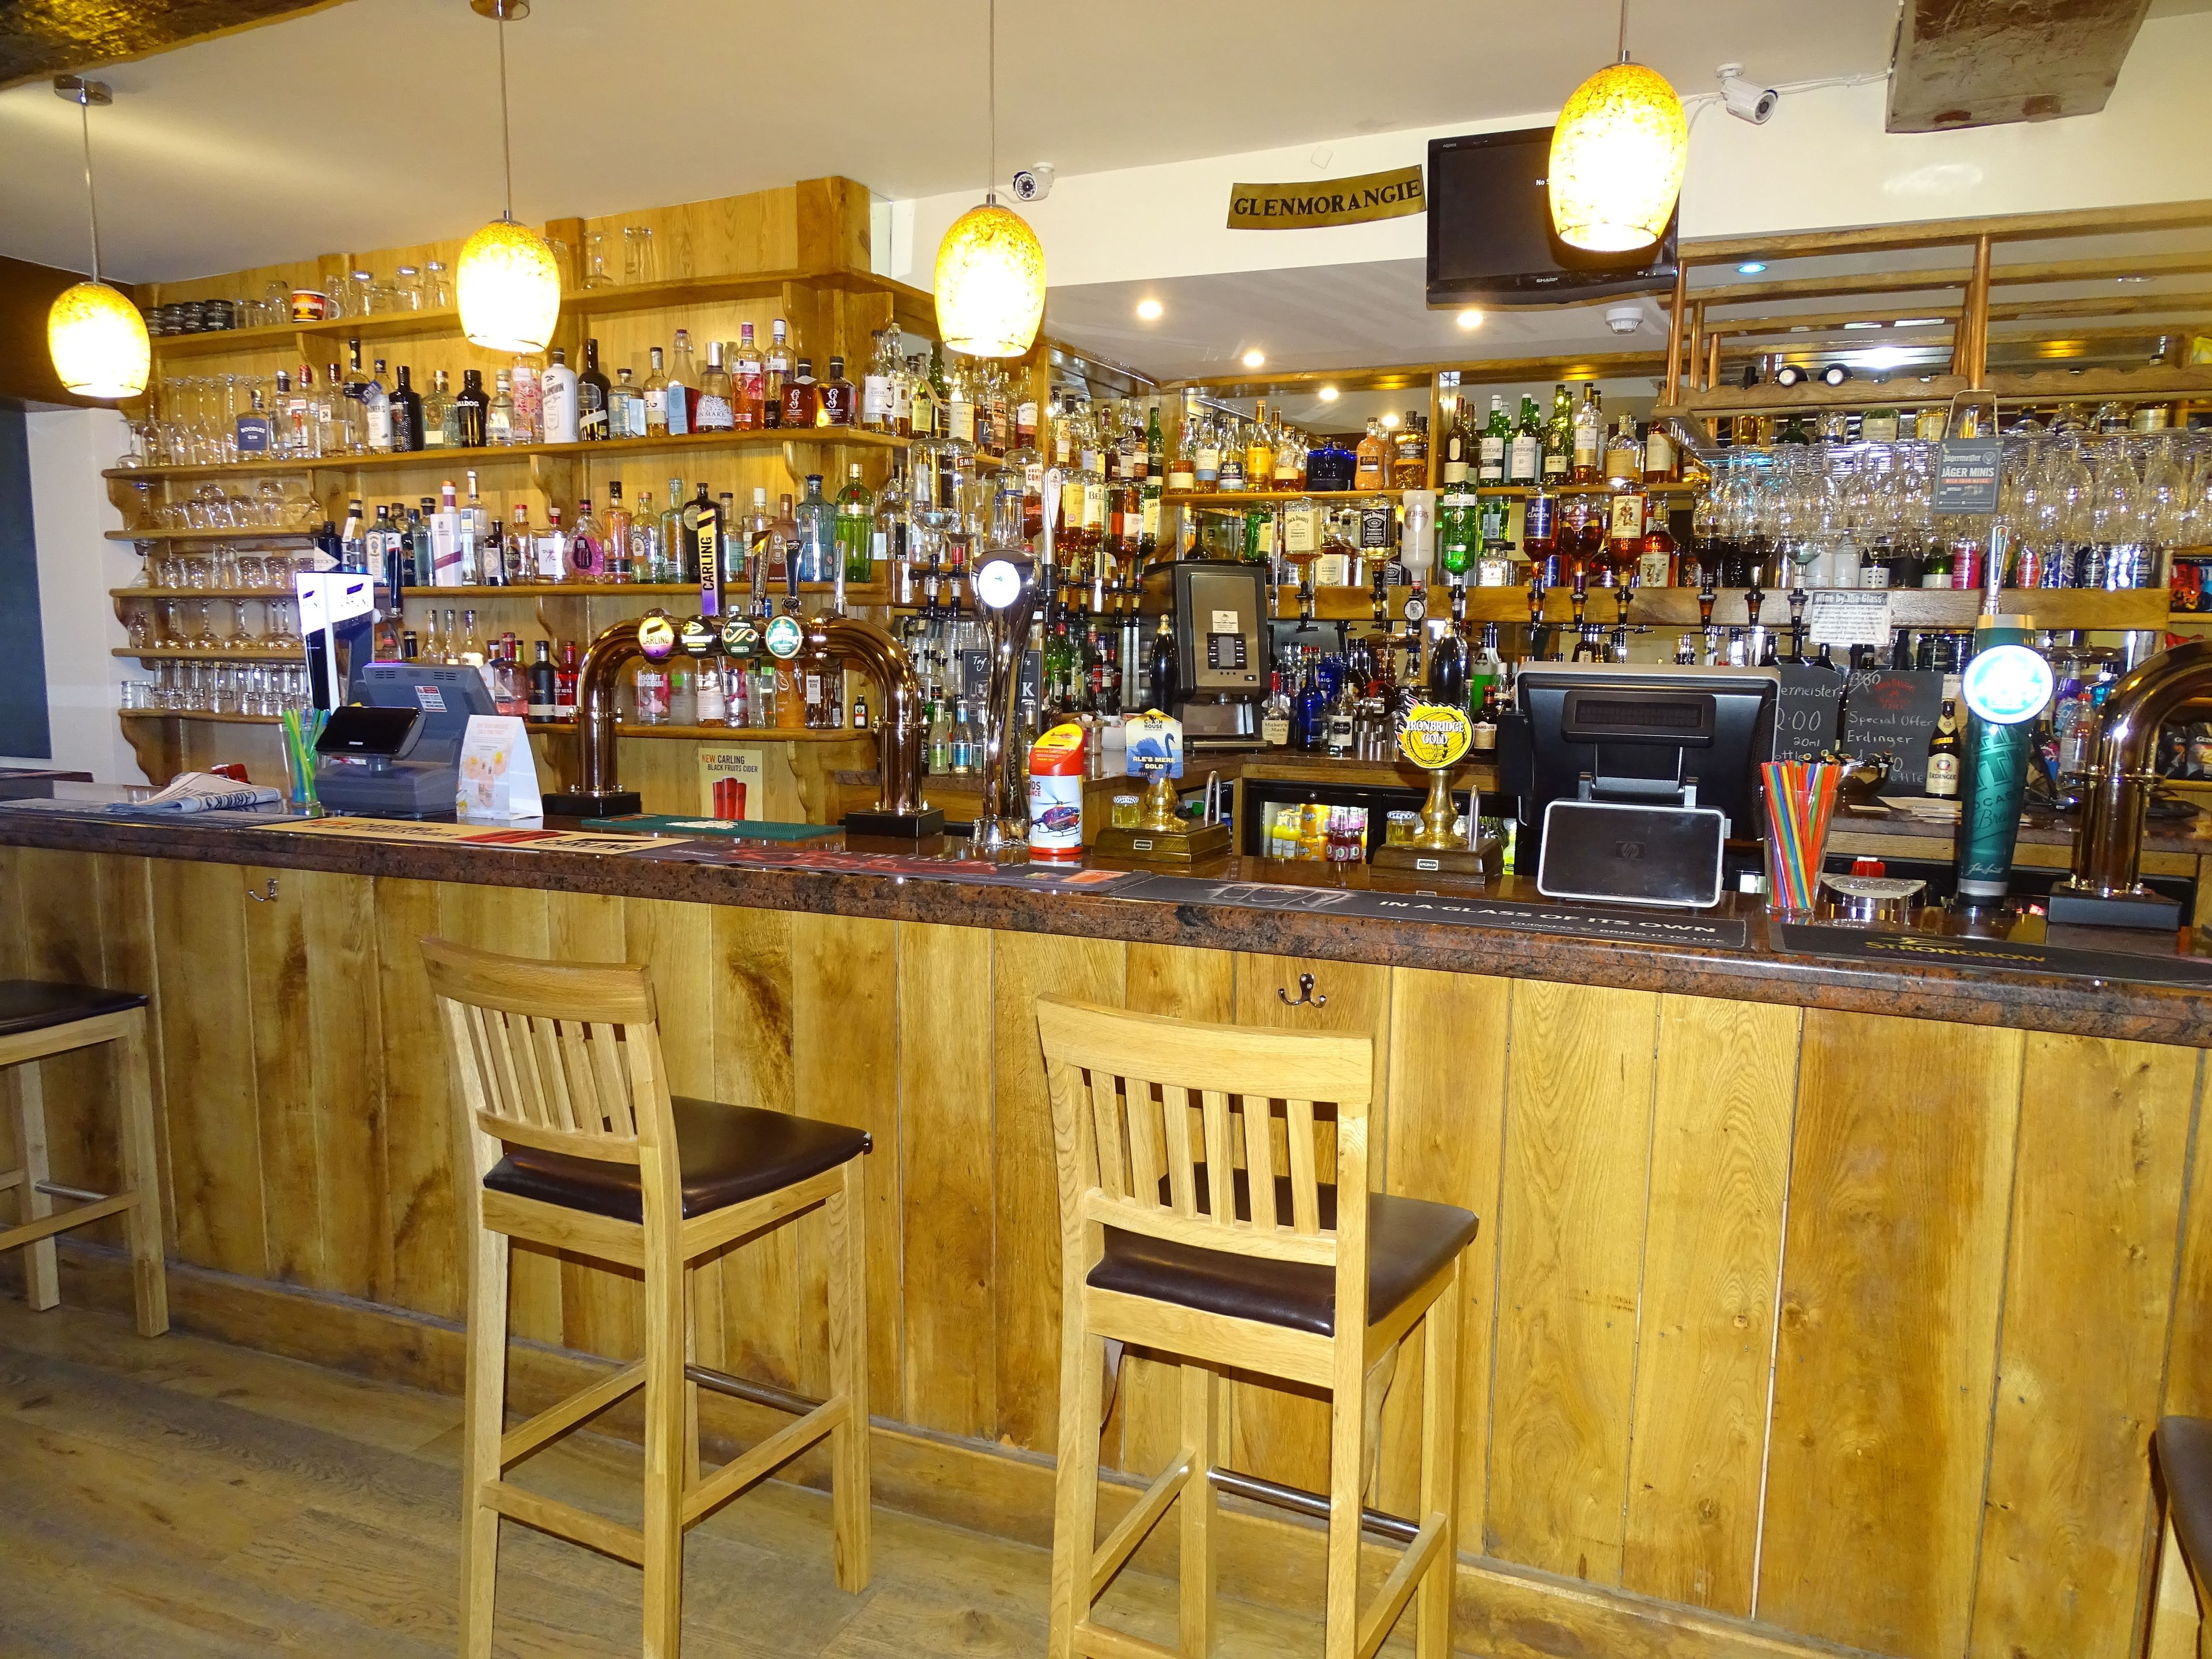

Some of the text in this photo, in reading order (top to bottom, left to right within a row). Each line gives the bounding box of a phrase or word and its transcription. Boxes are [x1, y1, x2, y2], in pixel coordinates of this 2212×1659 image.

[1233, 180, 1422, 217] GLENMORANGIE
[1941, 466, 1994, 477] JÄGER MINIS
[700, 536, 714, 592] CARLING
[1815, 593, 1883, 604] Wine by the Glass
[642, 635, 669, 645] CARLING
[973, 656, 987, 672] Try
[1781, 684, 1840, 697] ermeister
[1849, 711, 1933, 727] Special Offer
[1406, 720, 1465, 733] IRONBRIDGE
[1423, 733, 1449, 745] GOLD
[1847, 730, 1914, 747] Erdinger
[702, 754, 745, 765] NEW CARLING
[707, 763, 759, 773] BLACK FRUITS CIDER
[1929, 772, 1957, 780] ERDINGER
[534, 839, 643, 852] CARLING
[1623, 843, 1636, 857] hp
[1441, 906, 1533, 917] GLASS
[1587, 917, 1631, 926] ITS
[1638, 922, 1716, 933] OWN
[1510, 921, 1574, 930] GUINNESS
[1865, 941, 2047, 963] STRONGBOW
